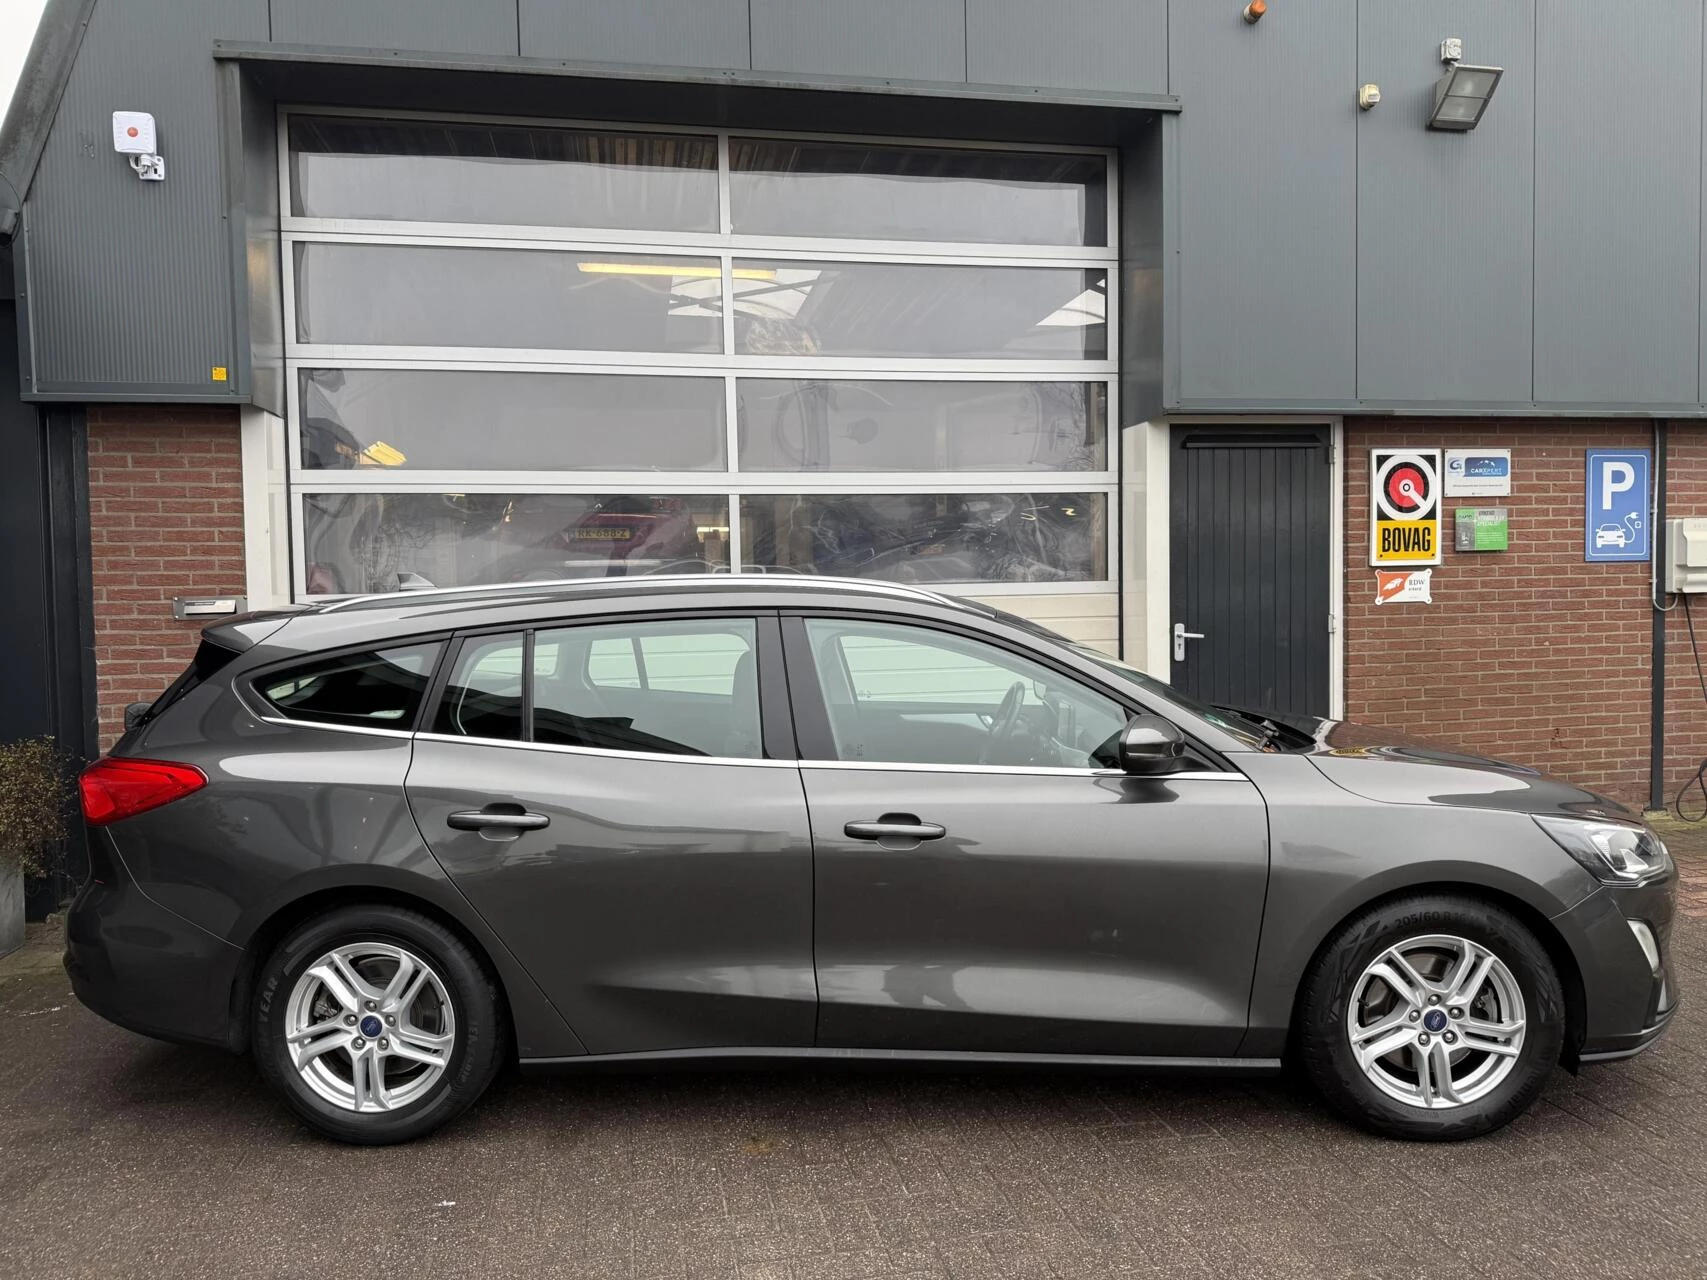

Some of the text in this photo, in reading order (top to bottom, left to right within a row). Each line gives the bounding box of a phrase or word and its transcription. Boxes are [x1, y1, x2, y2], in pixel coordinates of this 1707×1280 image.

[1602, 461, 1635, 510] P
[1382, 526, 1431, 552] BOVAG
[1395, 911, 1441, 928] 205/60
